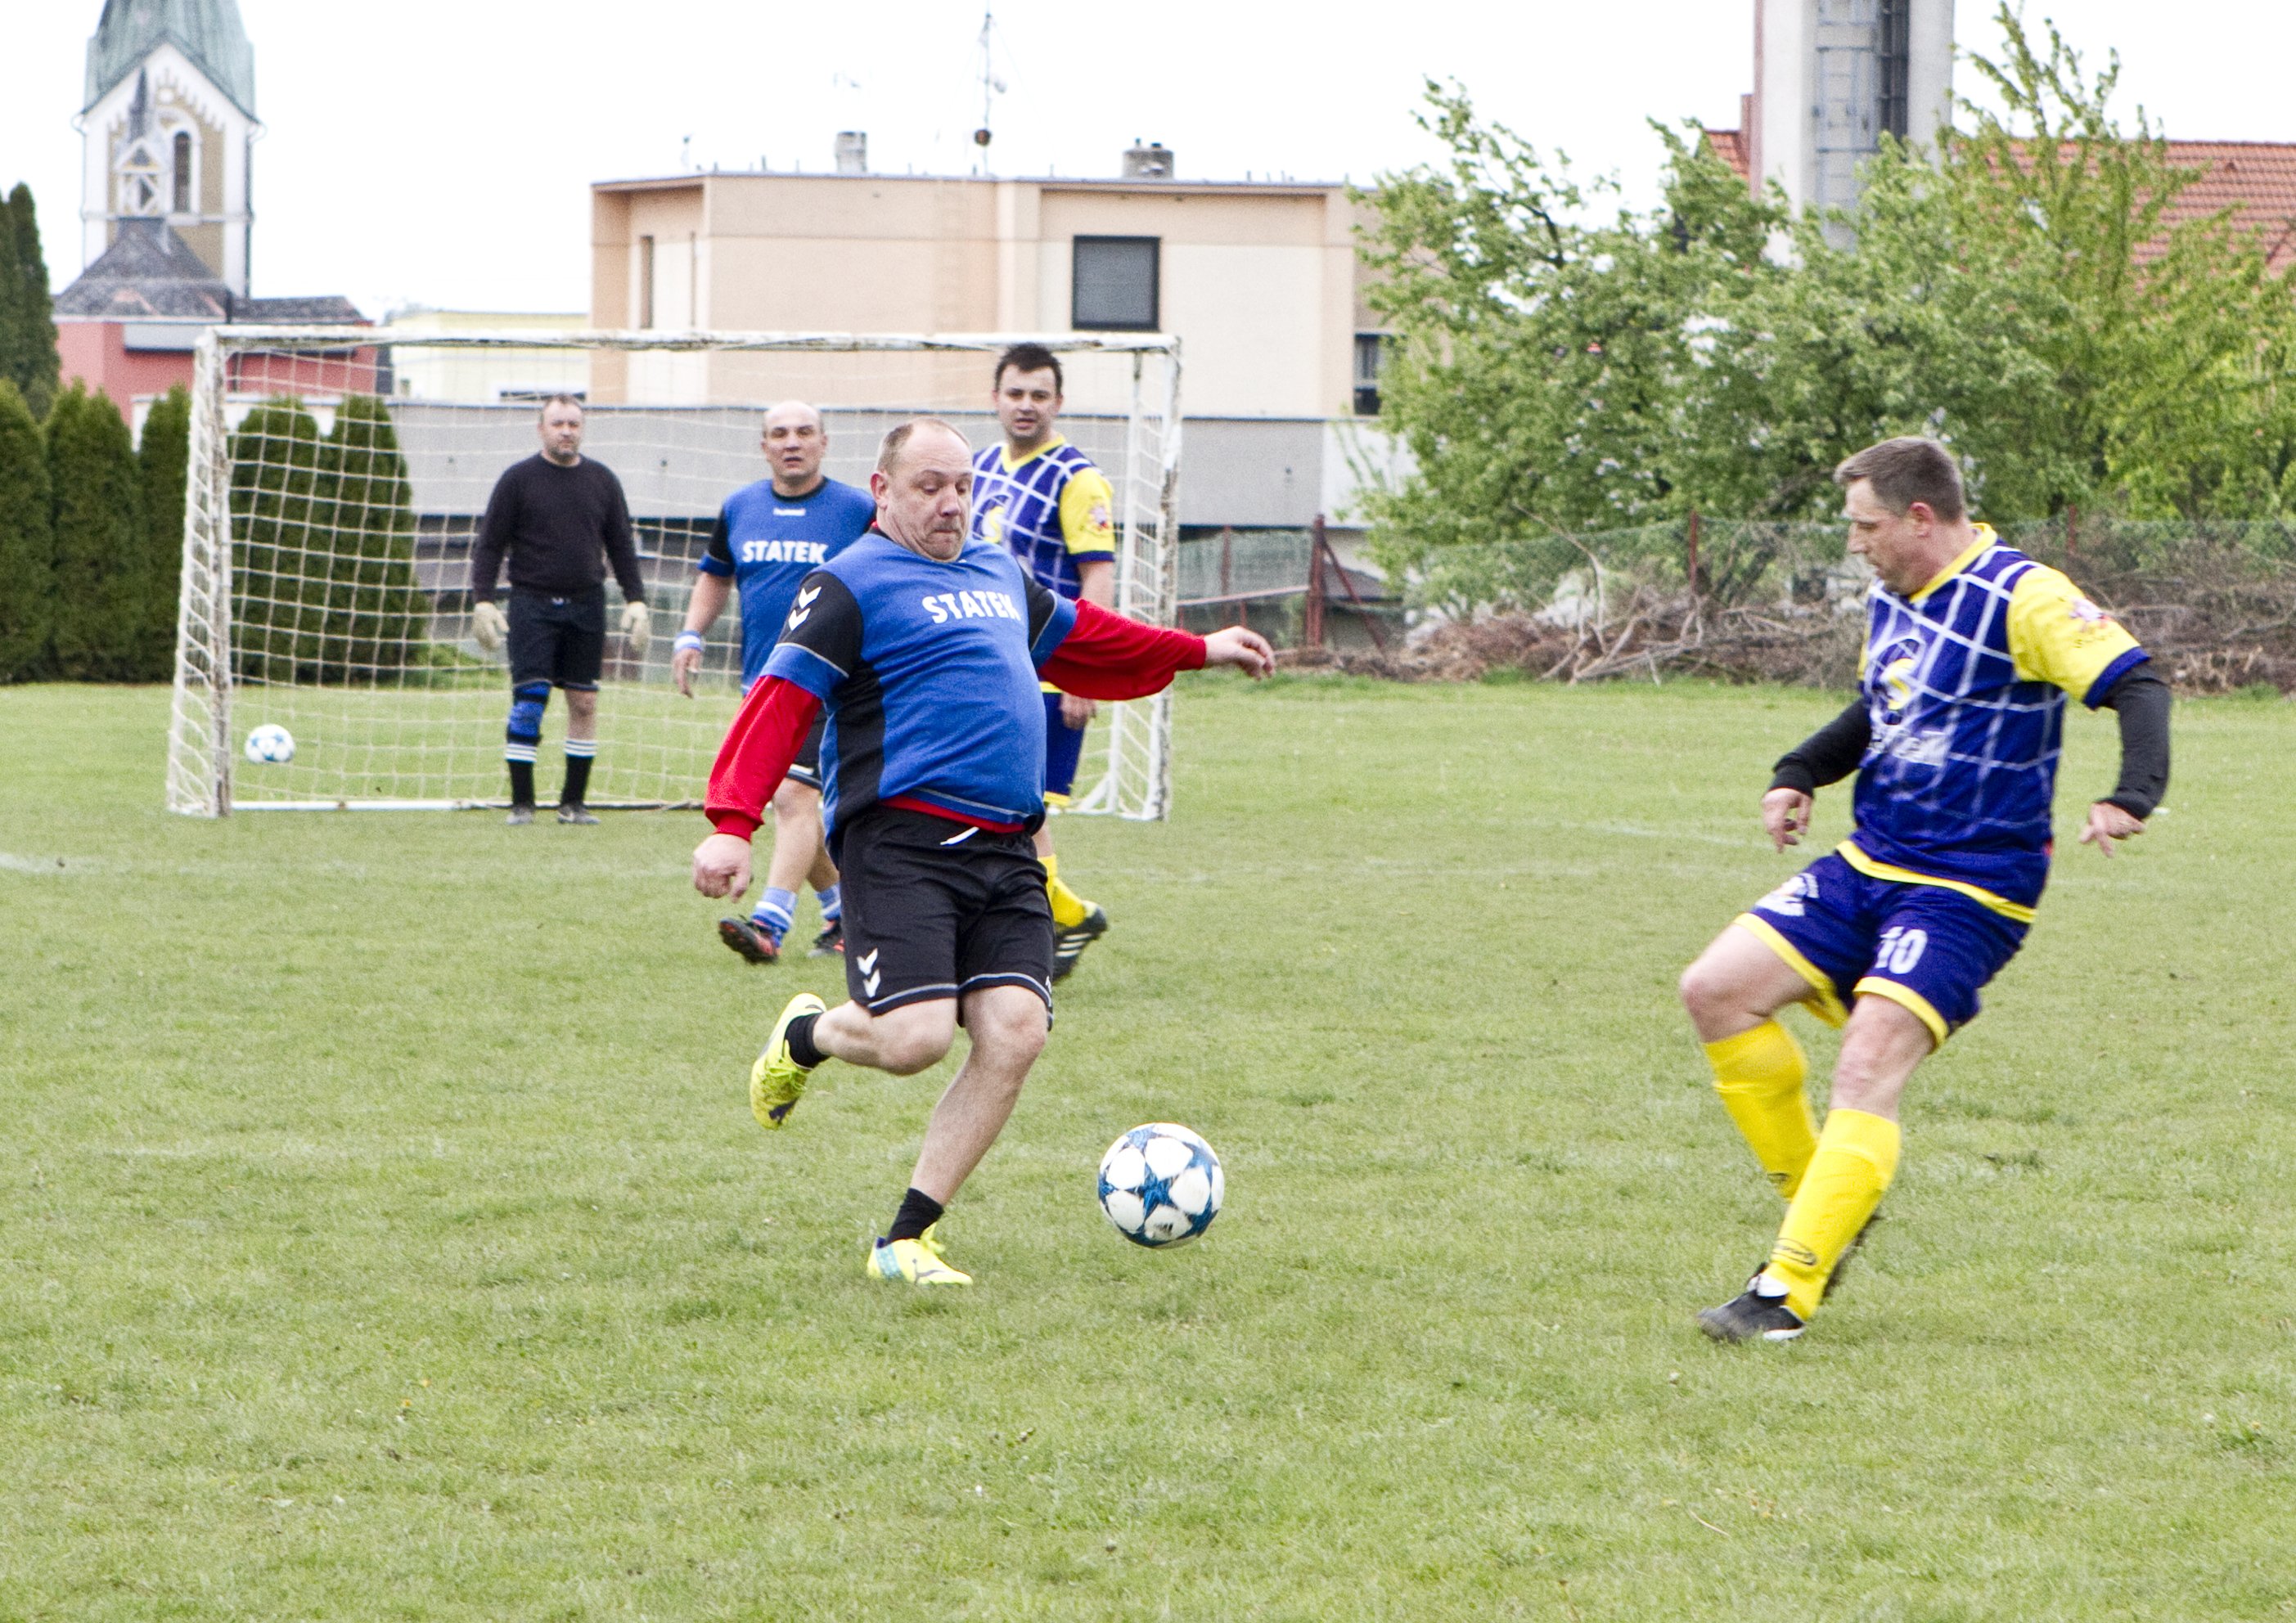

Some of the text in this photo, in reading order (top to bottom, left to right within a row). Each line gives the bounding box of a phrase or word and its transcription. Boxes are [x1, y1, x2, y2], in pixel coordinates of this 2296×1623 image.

[742, 540, 829, 564] STATEK
[921, 590, 1022, 624] STATEK
[1875, 925, 1929, 975] 10
